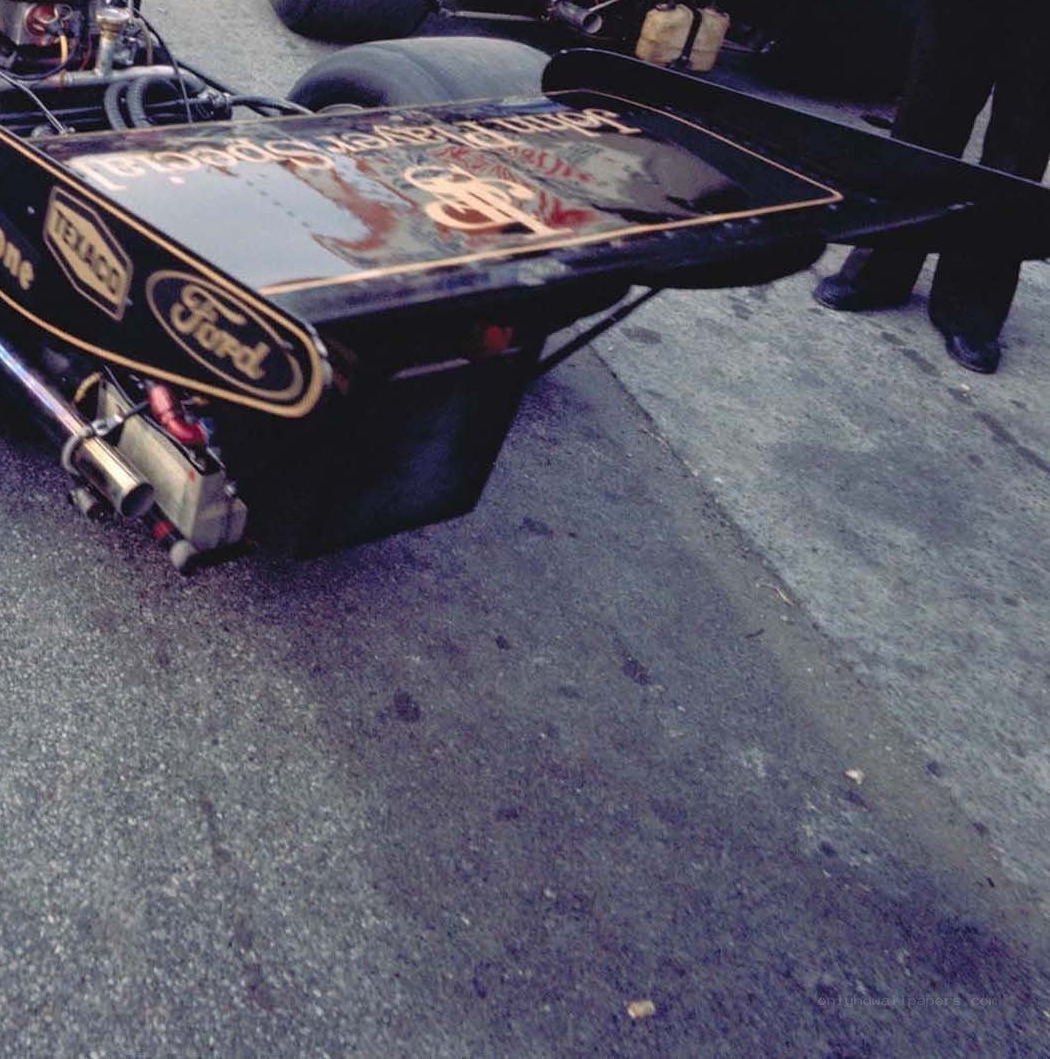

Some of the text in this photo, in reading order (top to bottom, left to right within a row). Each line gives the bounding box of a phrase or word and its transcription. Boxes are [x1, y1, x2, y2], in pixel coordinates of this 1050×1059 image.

[61, 107, 643, 192] John Player Special
[52, 209, 120, 295] TEXACO
[171, 284, 271, 380] Ford
